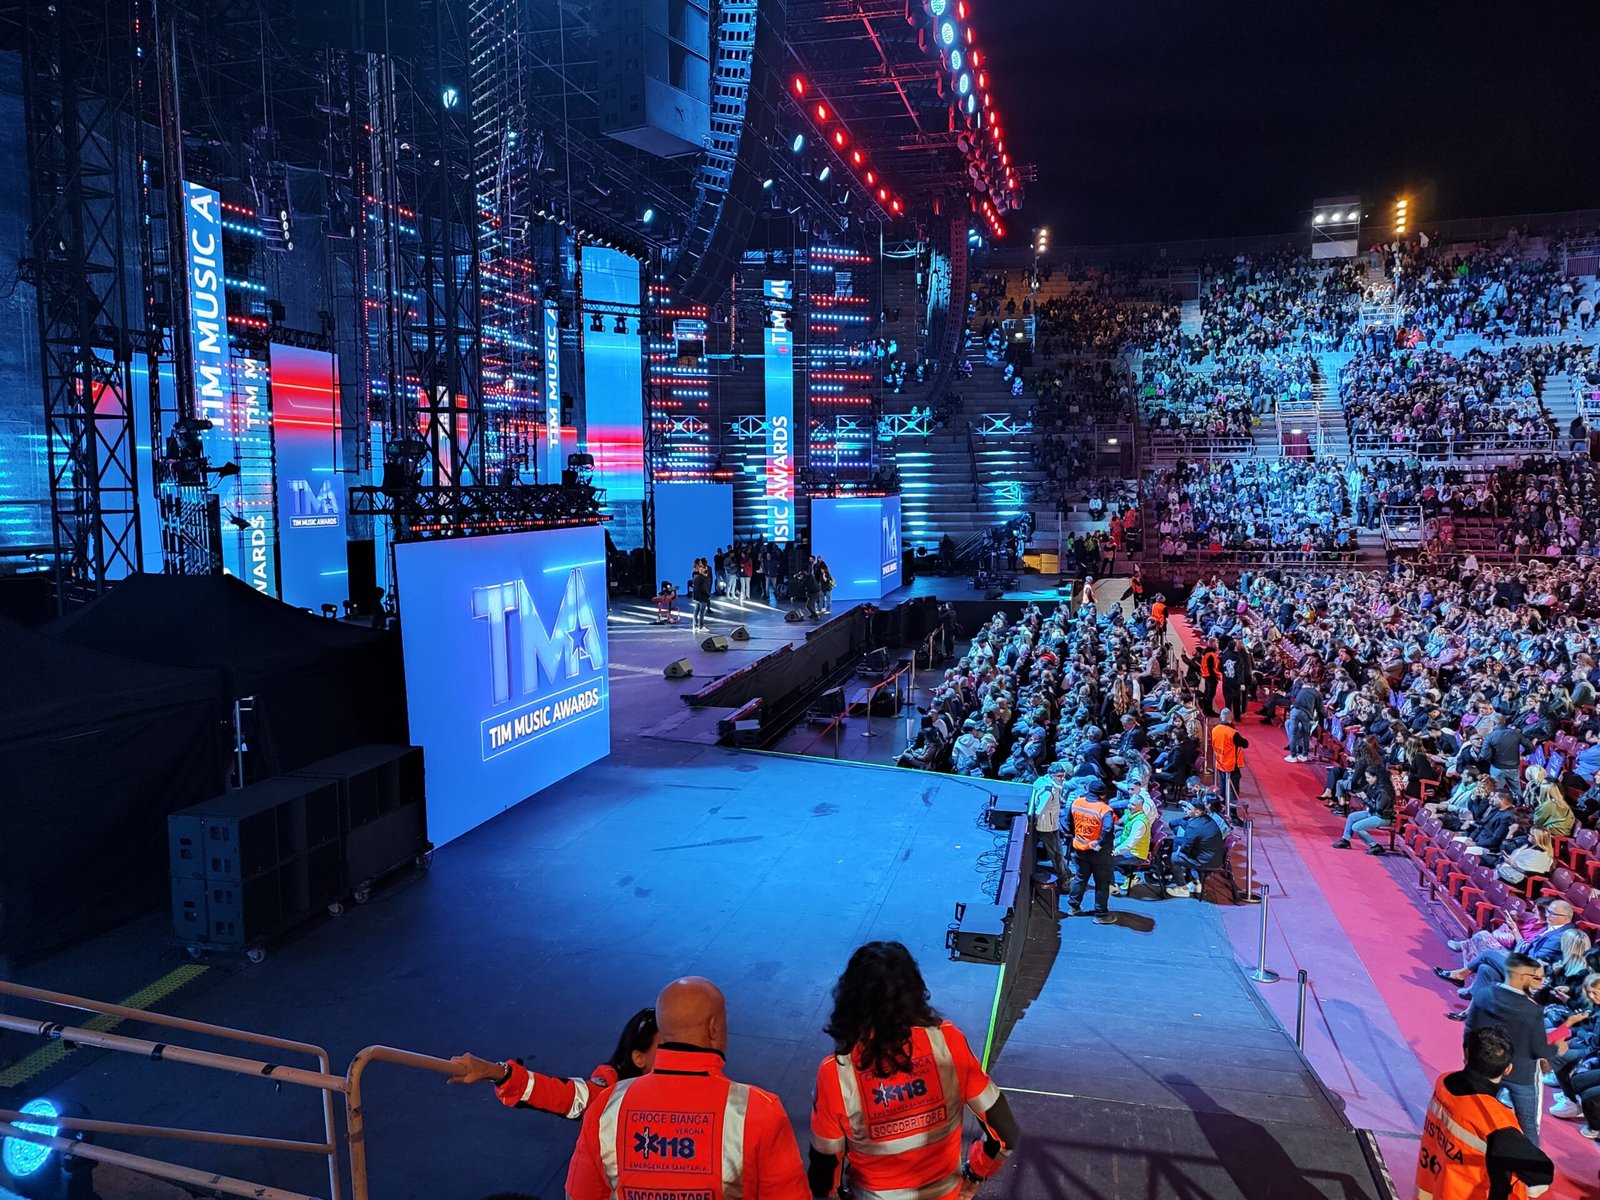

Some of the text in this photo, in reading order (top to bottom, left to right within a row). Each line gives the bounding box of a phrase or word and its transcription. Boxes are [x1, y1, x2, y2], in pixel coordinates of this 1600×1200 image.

[191, 229, 222, 354] MUSIC
[547, 324, 559, 401] MUSIC
[200, 366, 224, 430] TIM
[245, 386, 260, 429] TIM
[548, 407, 560, 449] TIM
[772, 415, 789, 502] AWARDS
[287, 479, 339, 515] TMA
[292, 517, 337, 527] TIM MUSIC AWARDS
[471, 567, 605, 707] TMA
[488, 687, 599, 749] TIM MUSIC AWARDS
[894, 1078, 927, 1102] 118
[631, 1112, 709, 1125] CROCE BIANCA
[675, 1127, 705, 1135] VERONA
[873, 1109, 944, 1137] SOCCORRITORE
[657, 1136, 695, 1159] 118
[1424, 1114, 1464, 1166] ISTENZA
